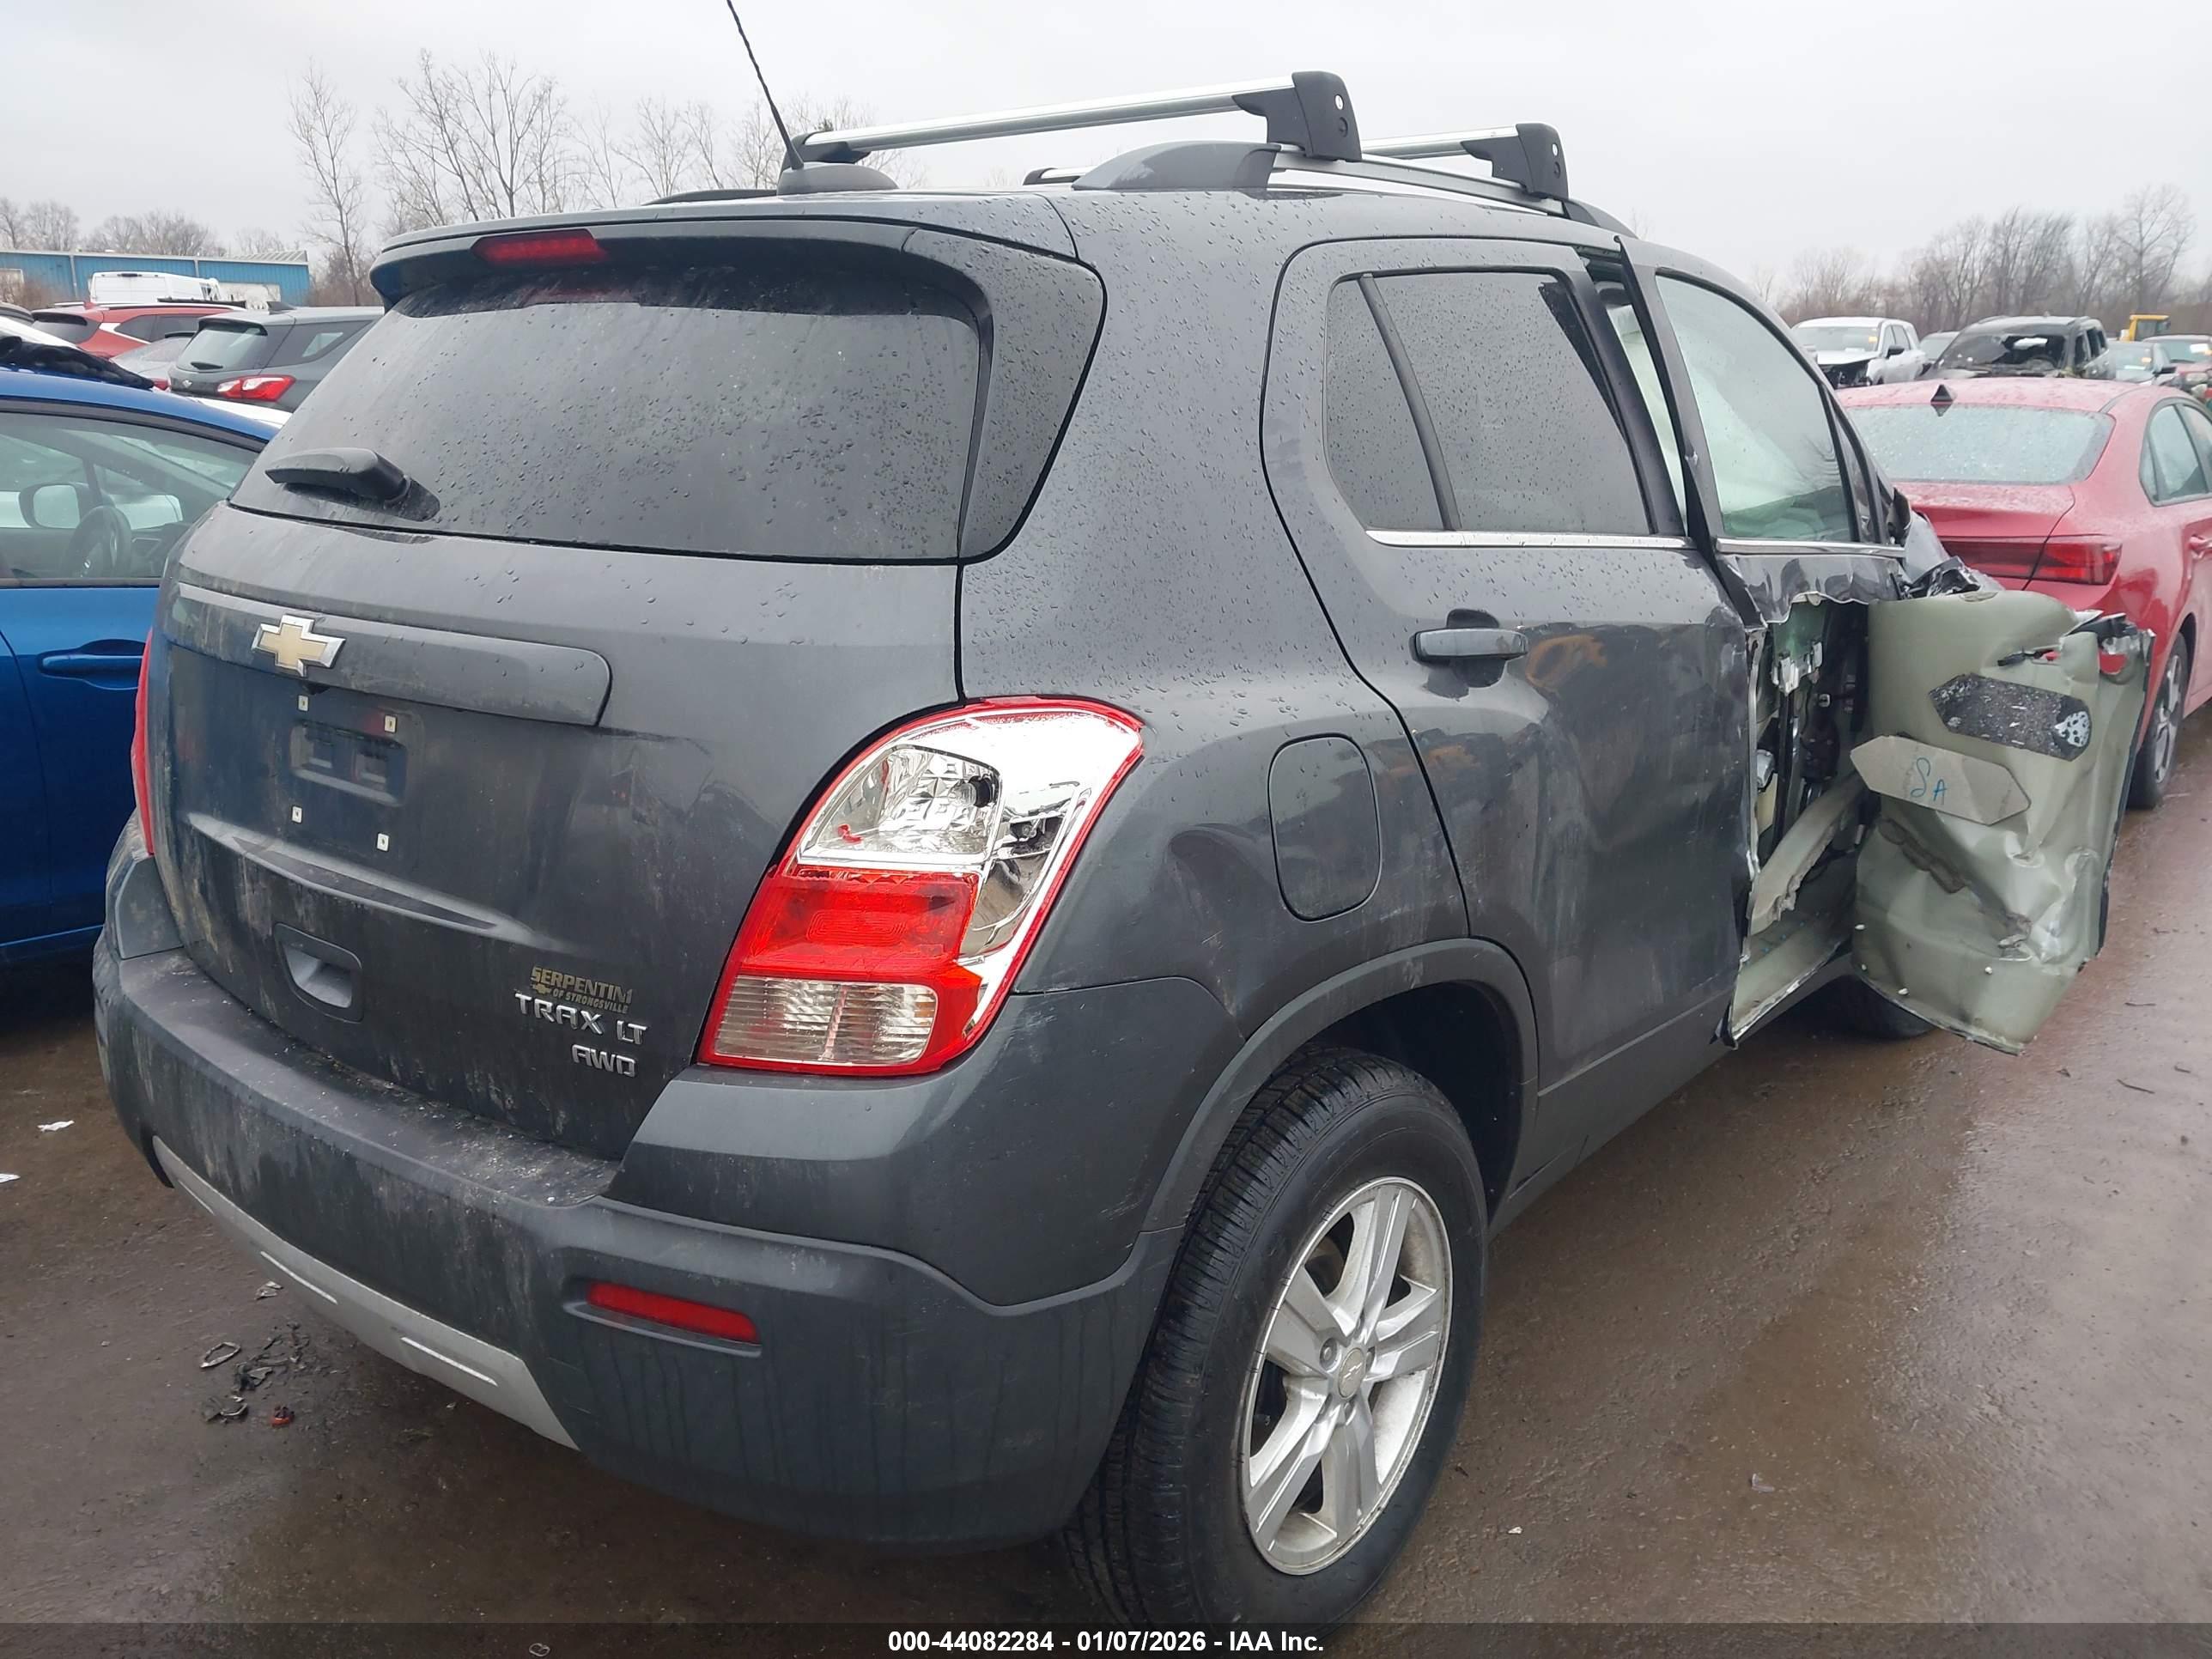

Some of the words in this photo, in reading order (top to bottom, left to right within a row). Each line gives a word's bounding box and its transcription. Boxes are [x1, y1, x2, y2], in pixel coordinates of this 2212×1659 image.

[514, 993, 603, 1035] TRAX
[617, 1019, 647, 1045] LT
[552, 989, 566, 1000] OF
[565, 991, 629, 1014] STRONGSVILLE
[572, 1044, 636, 1079] AWD
